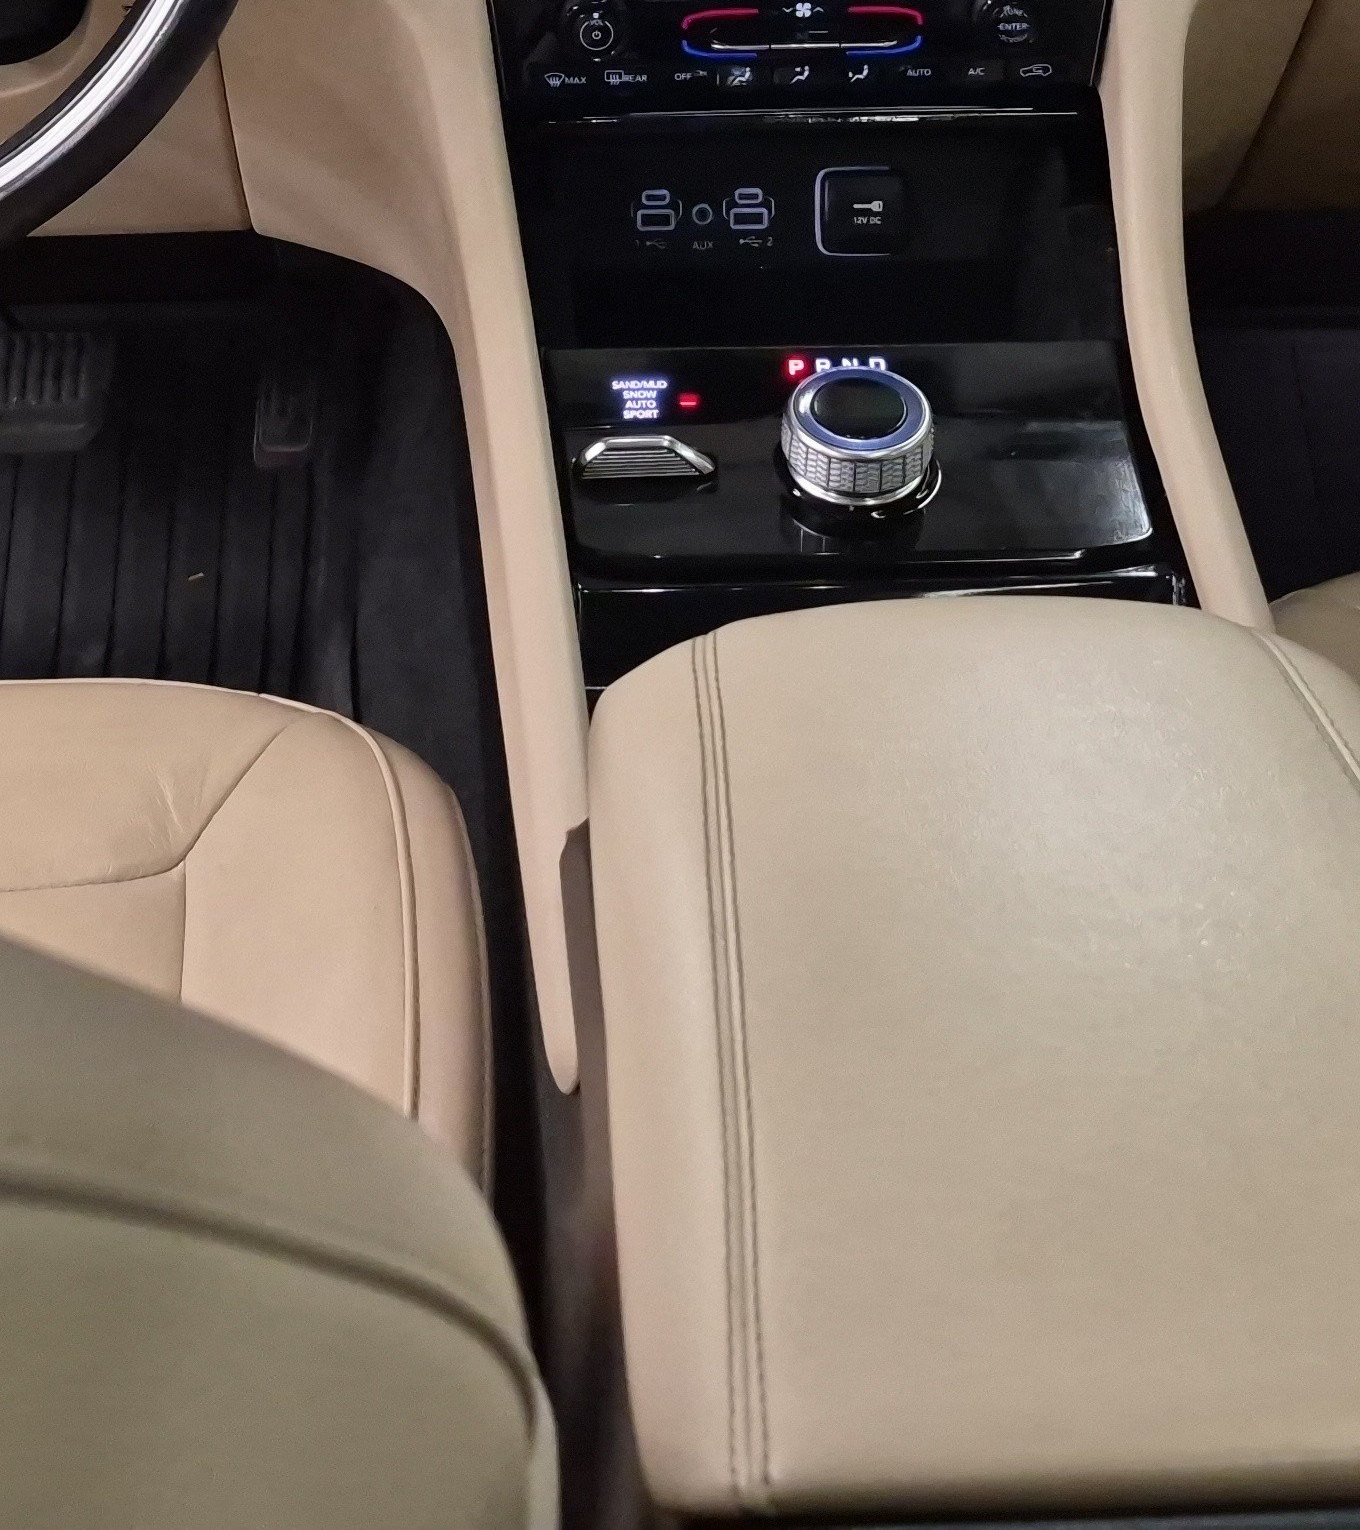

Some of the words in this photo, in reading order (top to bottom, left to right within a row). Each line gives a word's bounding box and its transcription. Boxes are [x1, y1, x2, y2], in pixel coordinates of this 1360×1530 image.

[906, 69, 932, 77] AUTO
[968, 67, 986, 75] A/C
[622, 74, 648, 82] REAR
[674, 73, 692, 81] OFF
[693, 240, 713, 249] AUX
[788, 358, 805, 376] P
[612, 380, 668, 390] SAND/MUD
[623, 390, 657, 399] SNOW
[625, 399, 657, 409] AUTO
[623, 409, 659, 419] SPORT
